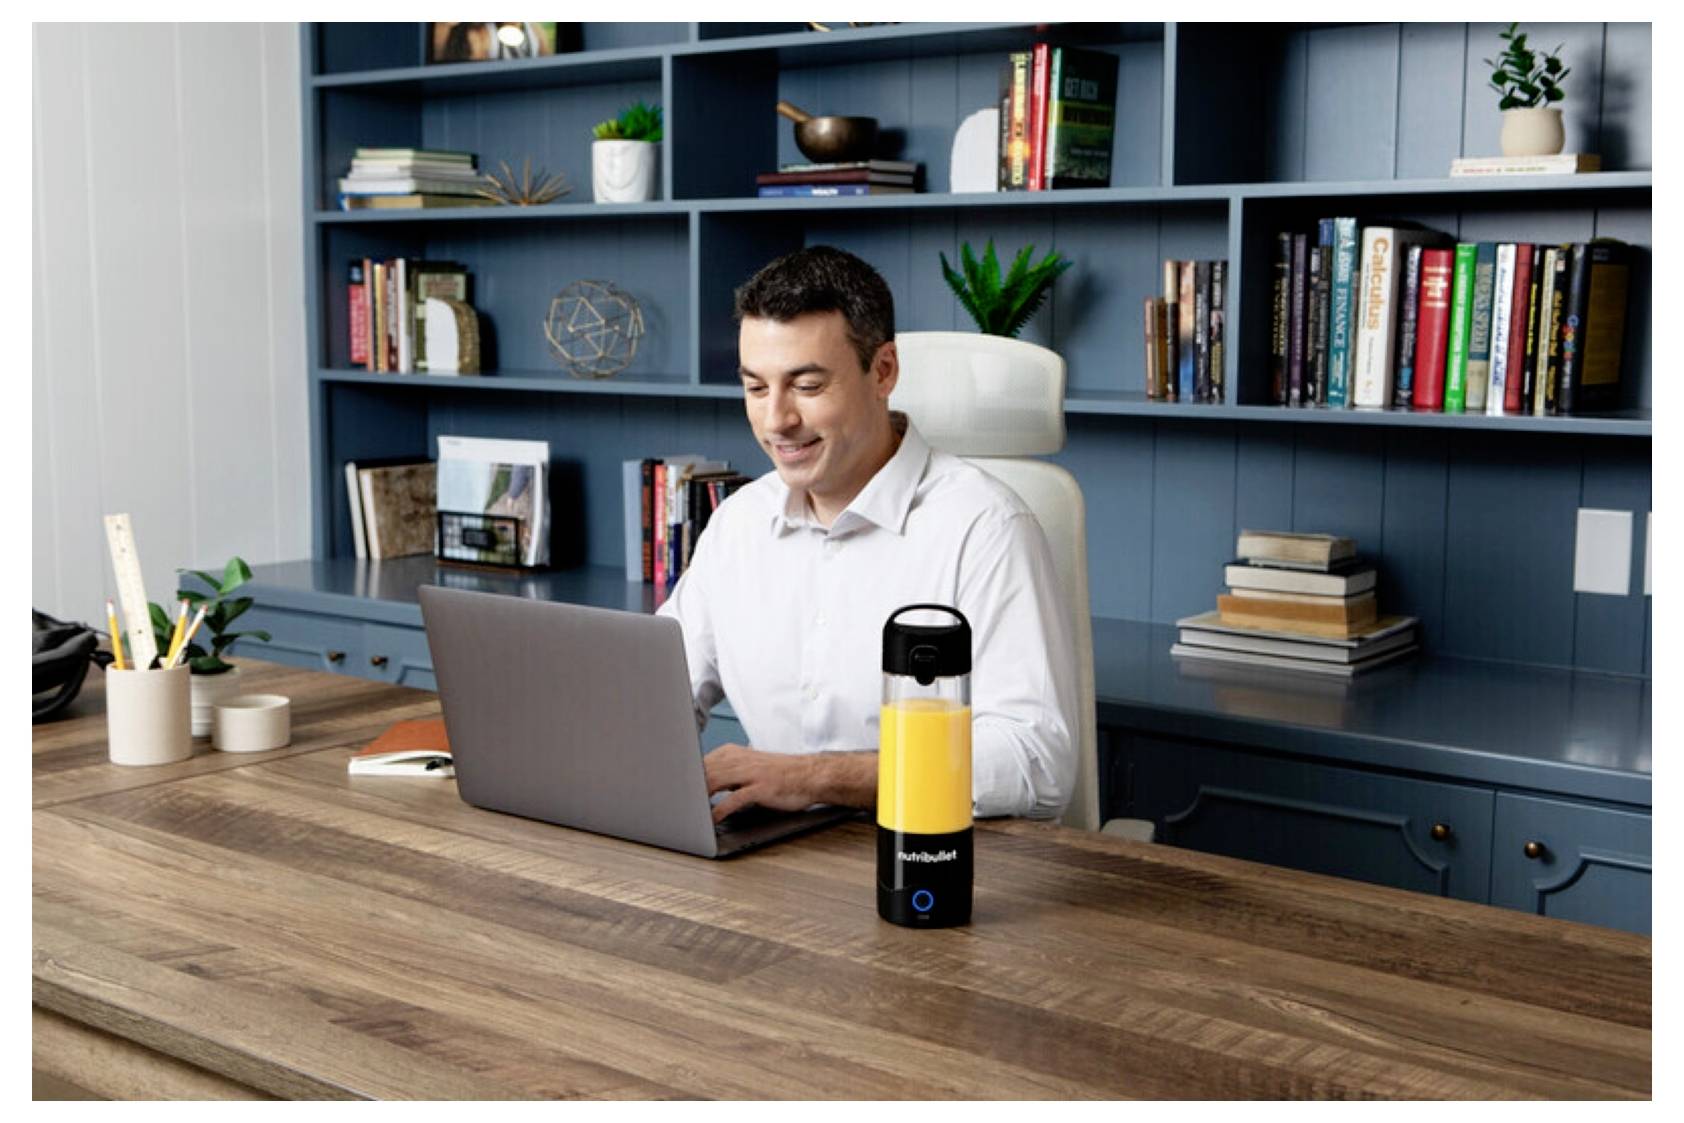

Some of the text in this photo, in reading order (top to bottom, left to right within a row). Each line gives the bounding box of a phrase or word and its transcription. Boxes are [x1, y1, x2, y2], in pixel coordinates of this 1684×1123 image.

[1366, 237, 1391, 331] Calculus
[1332, 287, 1348, 349] FINANCE
[897, 849, 957, 863] nutribullet
